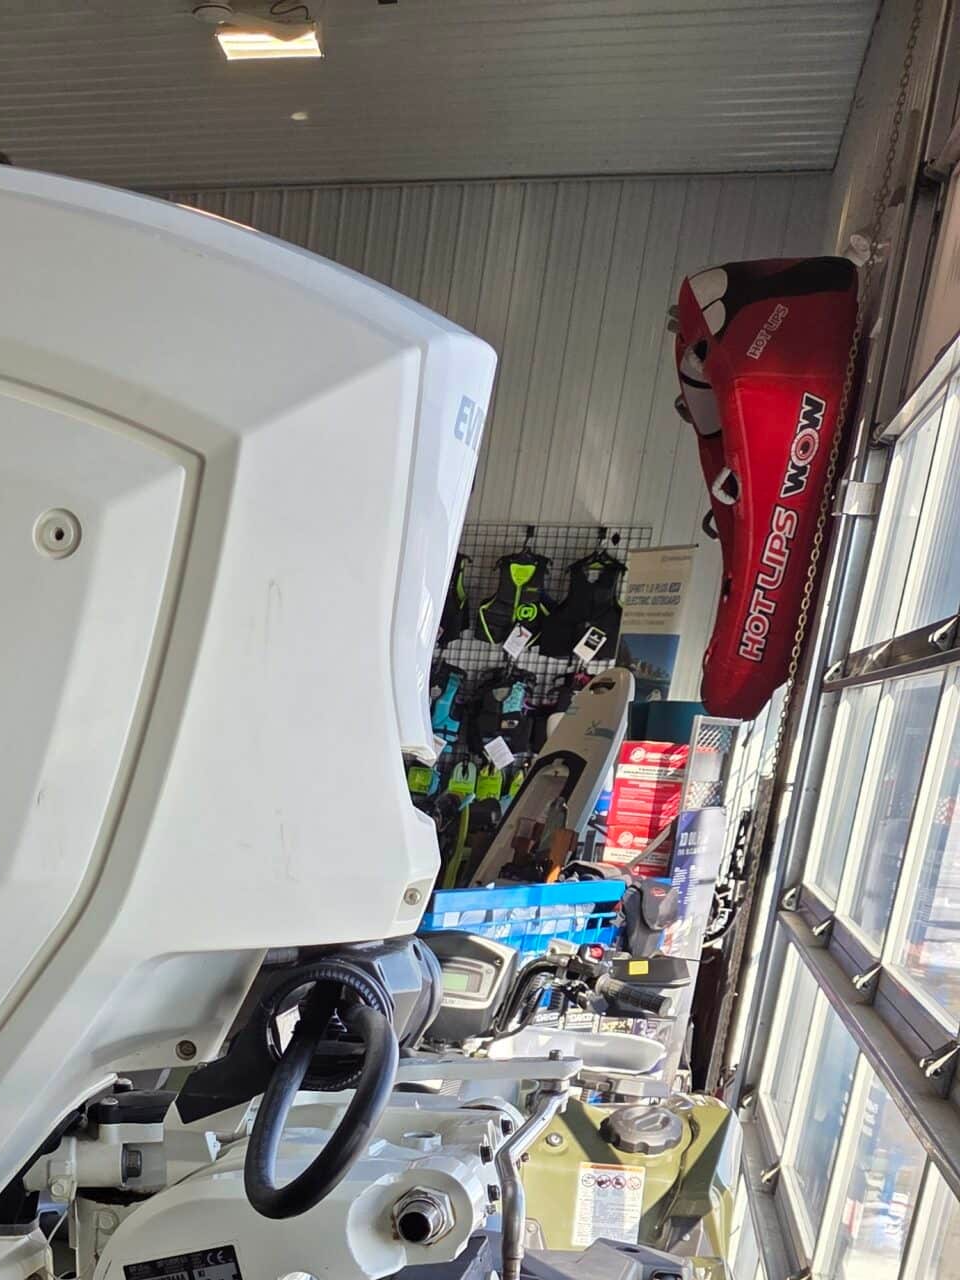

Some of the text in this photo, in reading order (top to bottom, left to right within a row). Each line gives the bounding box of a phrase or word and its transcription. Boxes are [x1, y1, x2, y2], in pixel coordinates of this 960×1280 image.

[740, 392, 826, 662] HOT LIPS WOW
